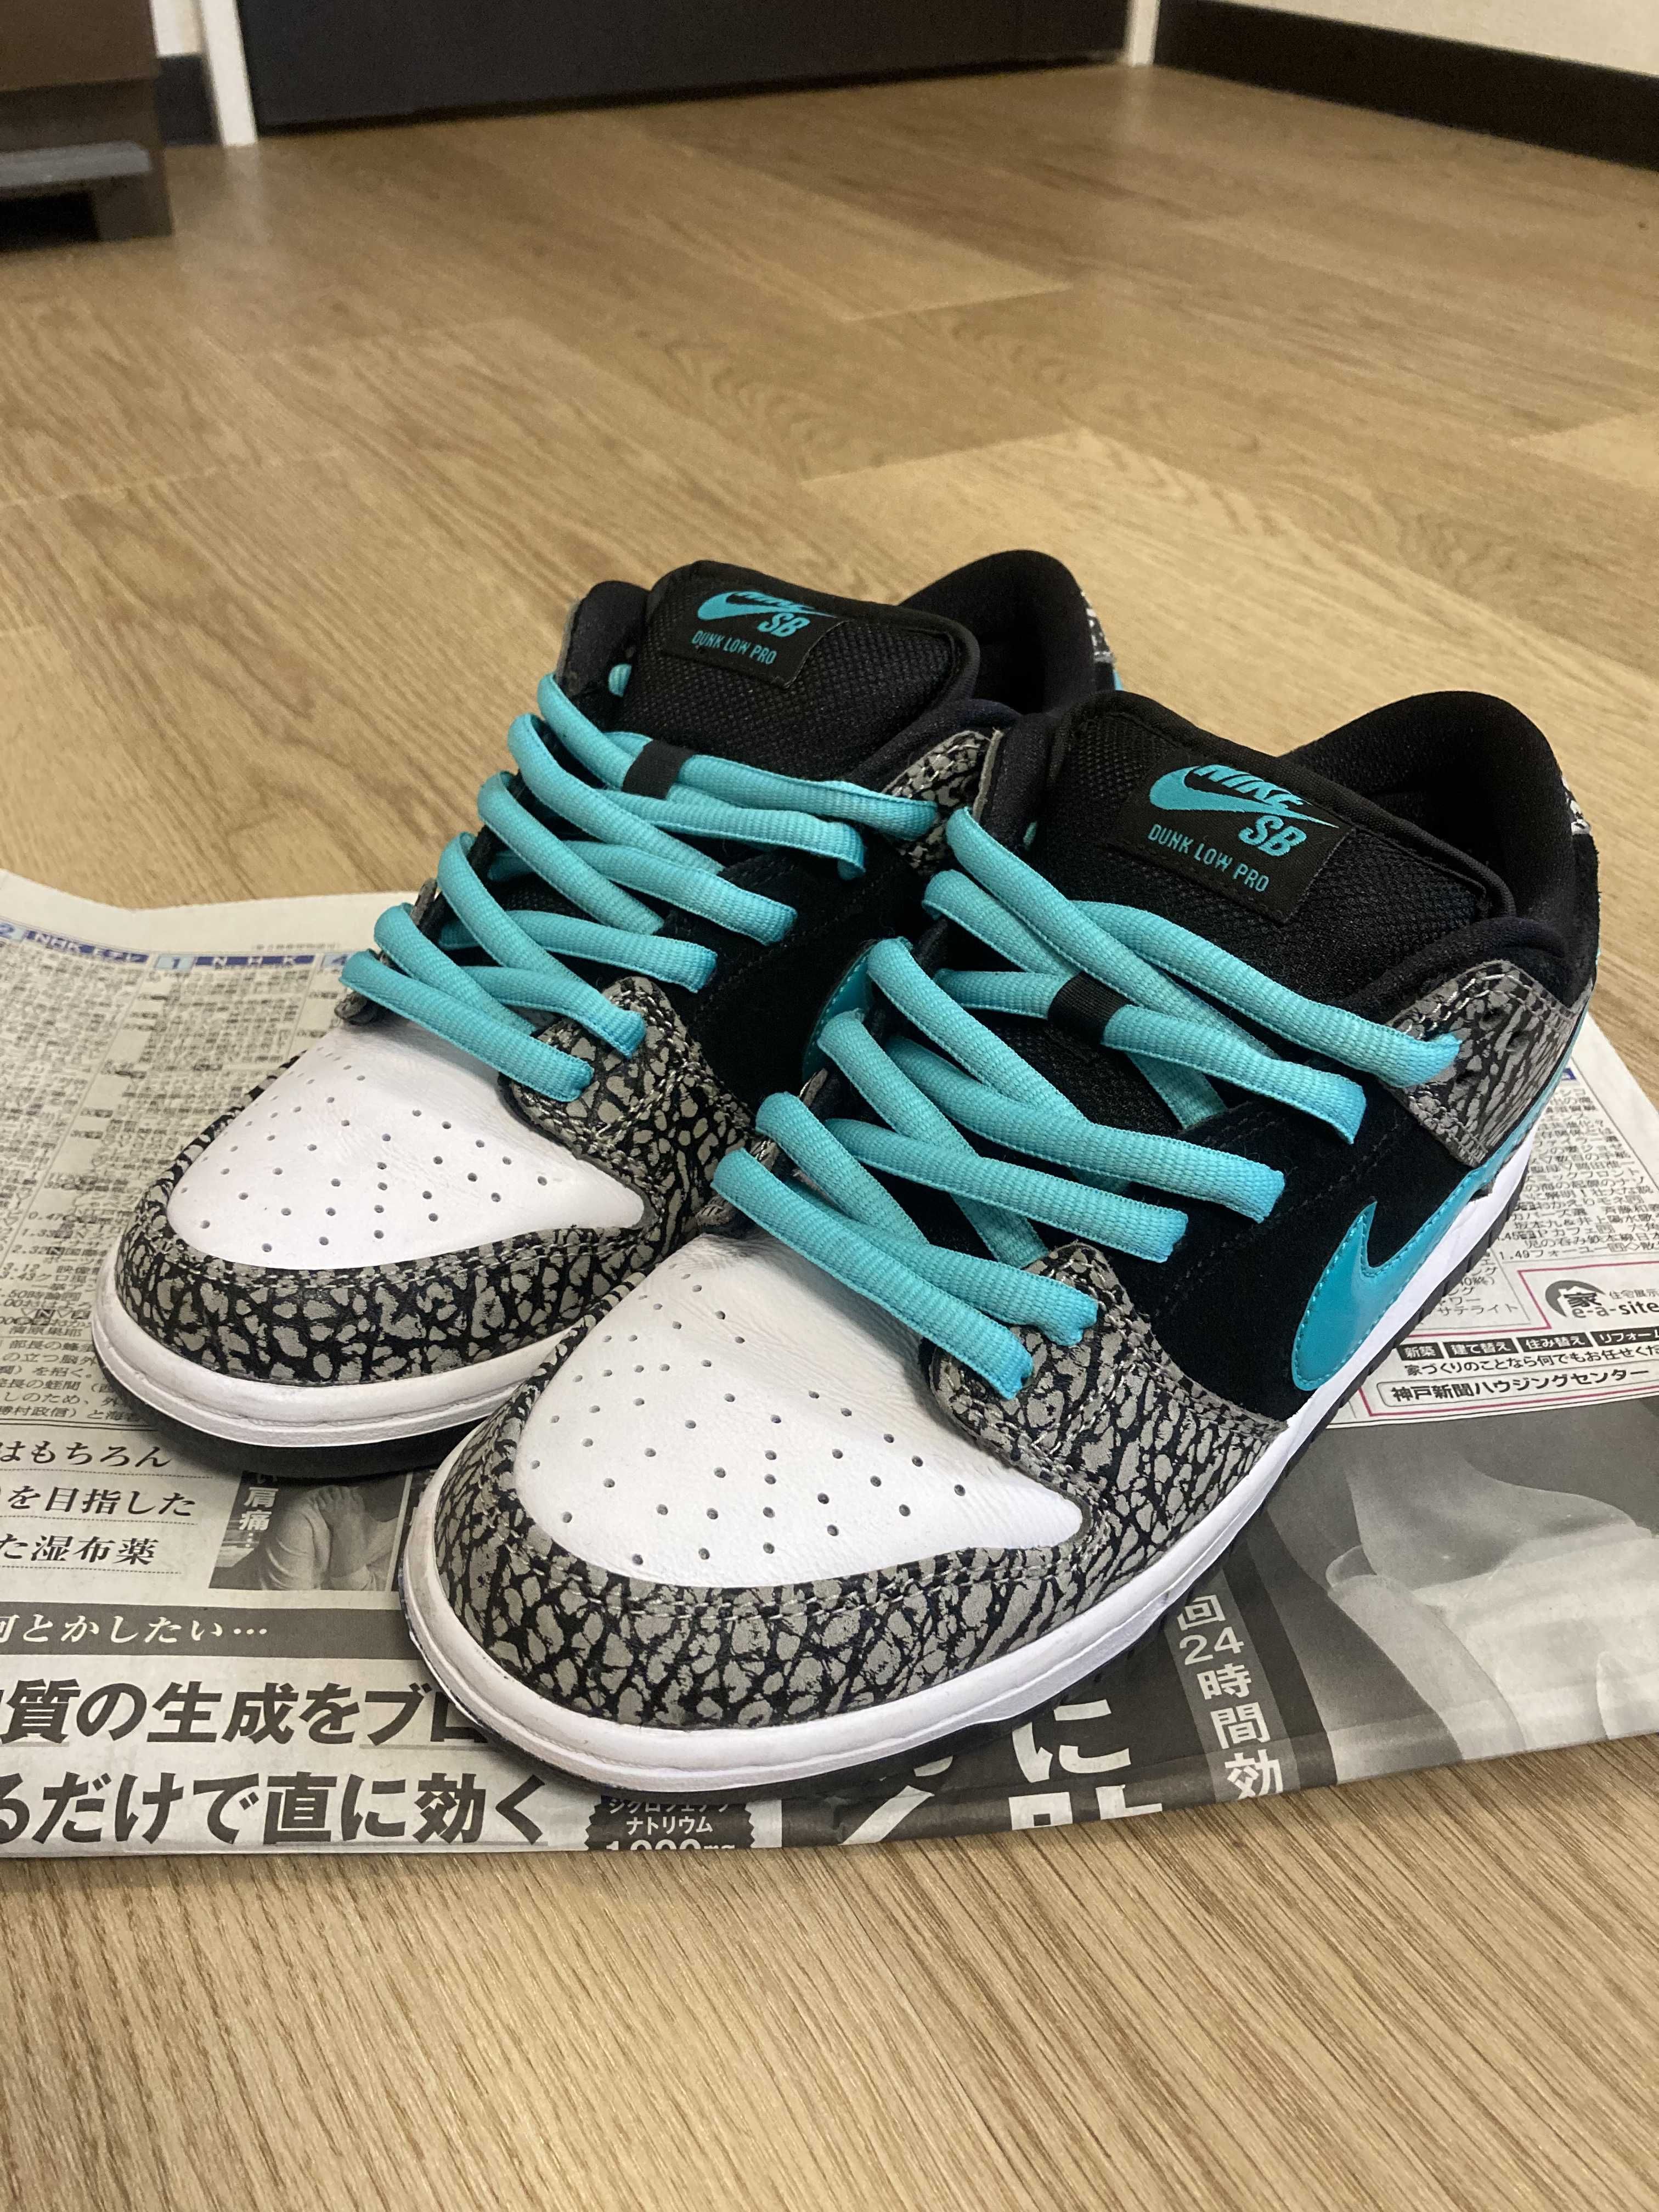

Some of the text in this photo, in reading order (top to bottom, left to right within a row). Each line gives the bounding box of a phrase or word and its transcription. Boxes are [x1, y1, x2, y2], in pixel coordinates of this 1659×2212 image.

[757, 613, 810, 637] SB
[692, 630, 777, 664] DUNK LOW PRO
[1193, 764, 1313, 809] NIKE
[1238, 815, 1307, 856] SB
[1148, 823, 1269, 893] DUNK LOW PRO
[1572, 1301, 1659, 1318] e-a-site
[1404, 1345, 1437, 1358] 新築
[1451, 1340, 1511, 1355] 建て替え
[1526, 1334, 1585, 1350] 住み替え
[1392, 1369, 1650, 1402] 神戸新聞ハウジングセンター
[0, 1679, 488, 1744] 質の生成をブロ
[627, 1816, 713, 1835] ナトリウム
